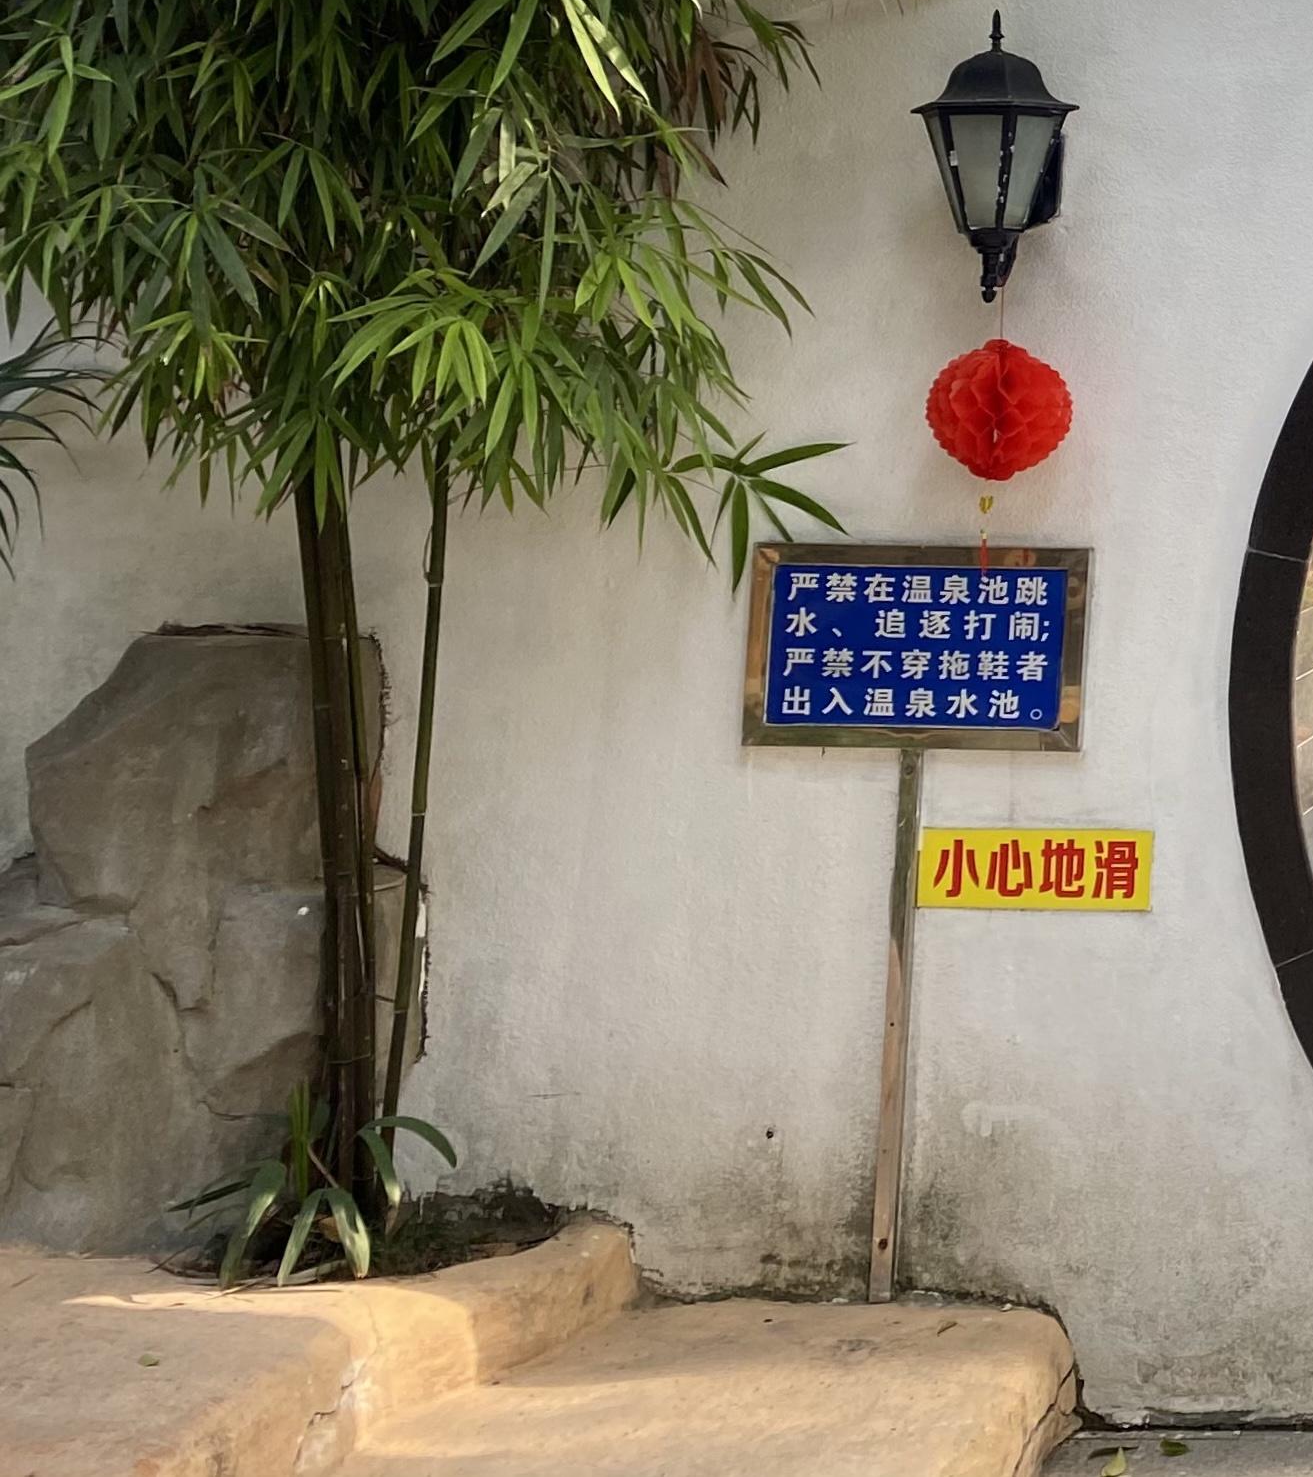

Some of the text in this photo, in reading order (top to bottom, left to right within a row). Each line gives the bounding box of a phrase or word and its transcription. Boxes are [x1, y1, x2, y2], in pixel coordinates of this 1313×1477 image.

[787, 572, 1049, 606] 严禁在温泉池跳
[783, 647, 1049, 682] 严禁不穿拖鞋者
[781, 687, 1043, 721] 出入温泉水池。
[933, 838, 1139, 900] 小心地滑
